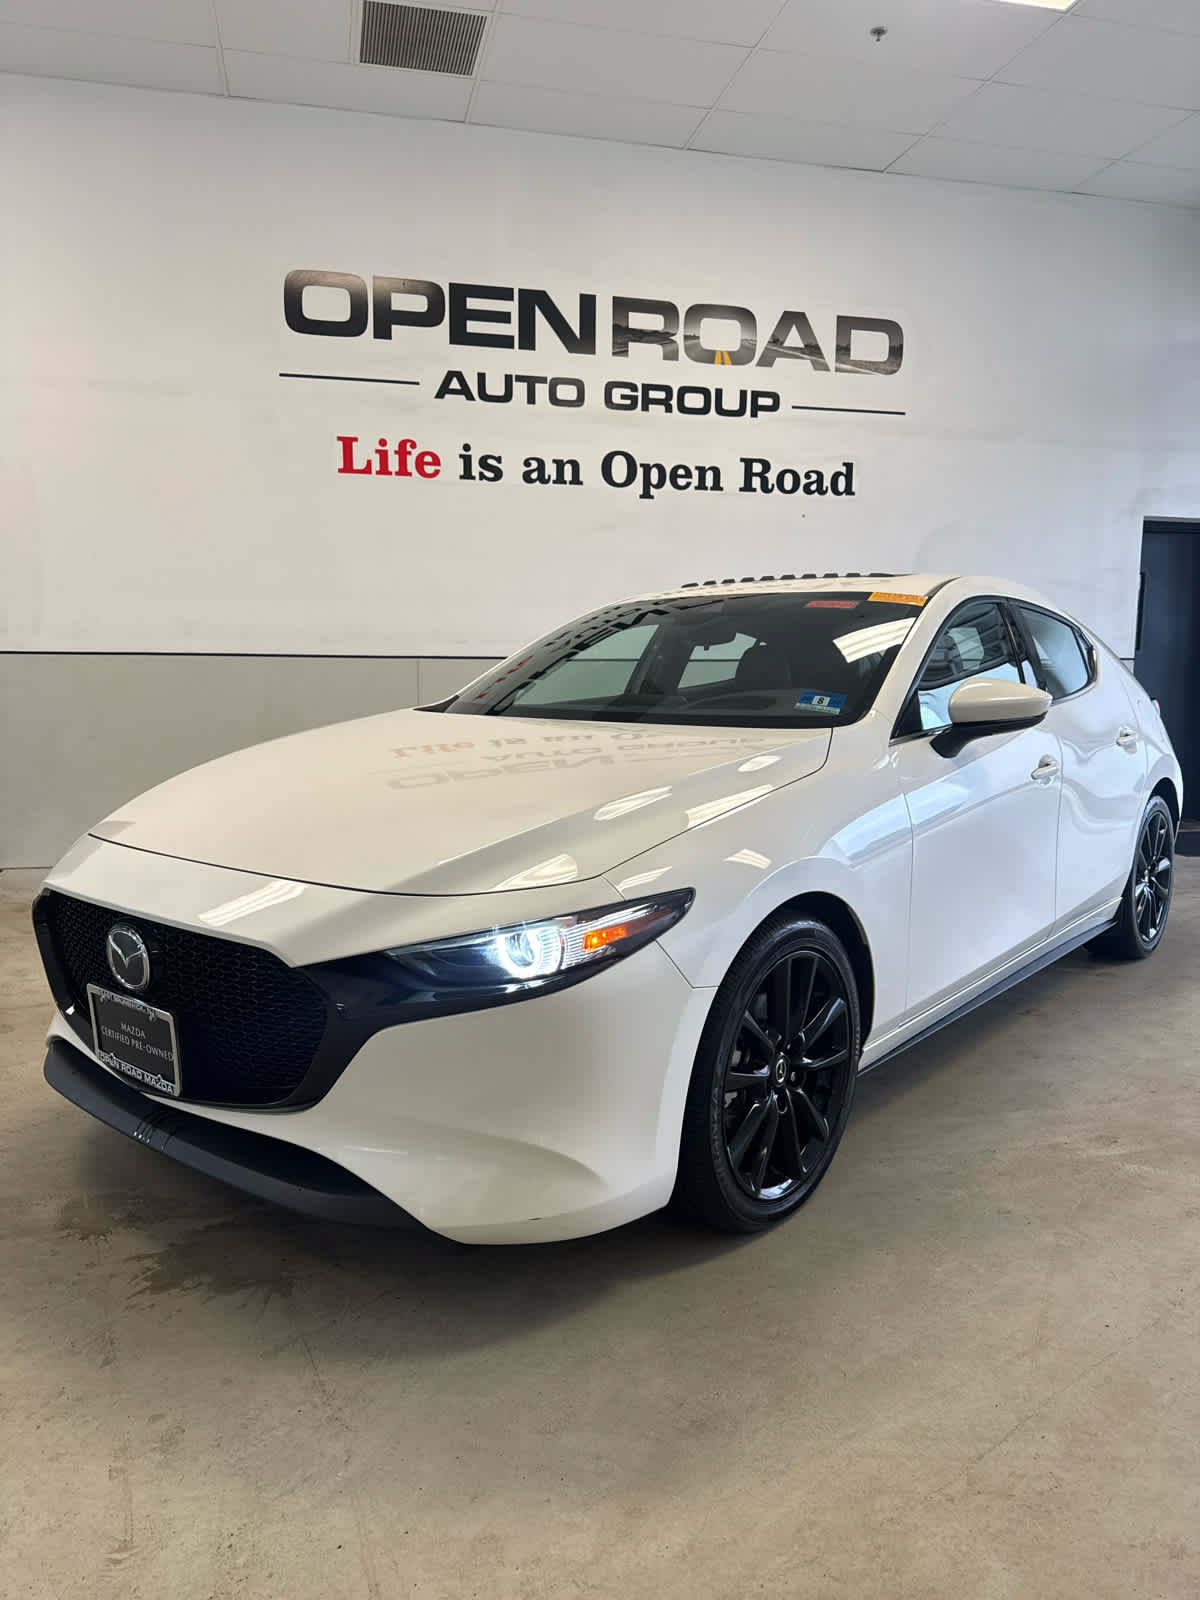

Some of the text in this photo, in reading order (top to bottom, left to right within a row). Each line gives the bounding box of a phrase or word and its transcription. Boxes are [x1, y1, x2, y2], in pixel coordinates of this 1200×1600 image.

[283, 269, 905, 376] OPEN ROAD
[434, 370, 781, 419] AUTO GROUP
[336, 435, 856, 500] Life is an Open Road
[101, 1025, 175, 1062] CERTIFIED PRE-OWNED
[121, 1023, 147, 1040] MAZDA
[121, 1063, 143, 1080] ROAD
[143, 1072, 174, 1095] MAZDA
